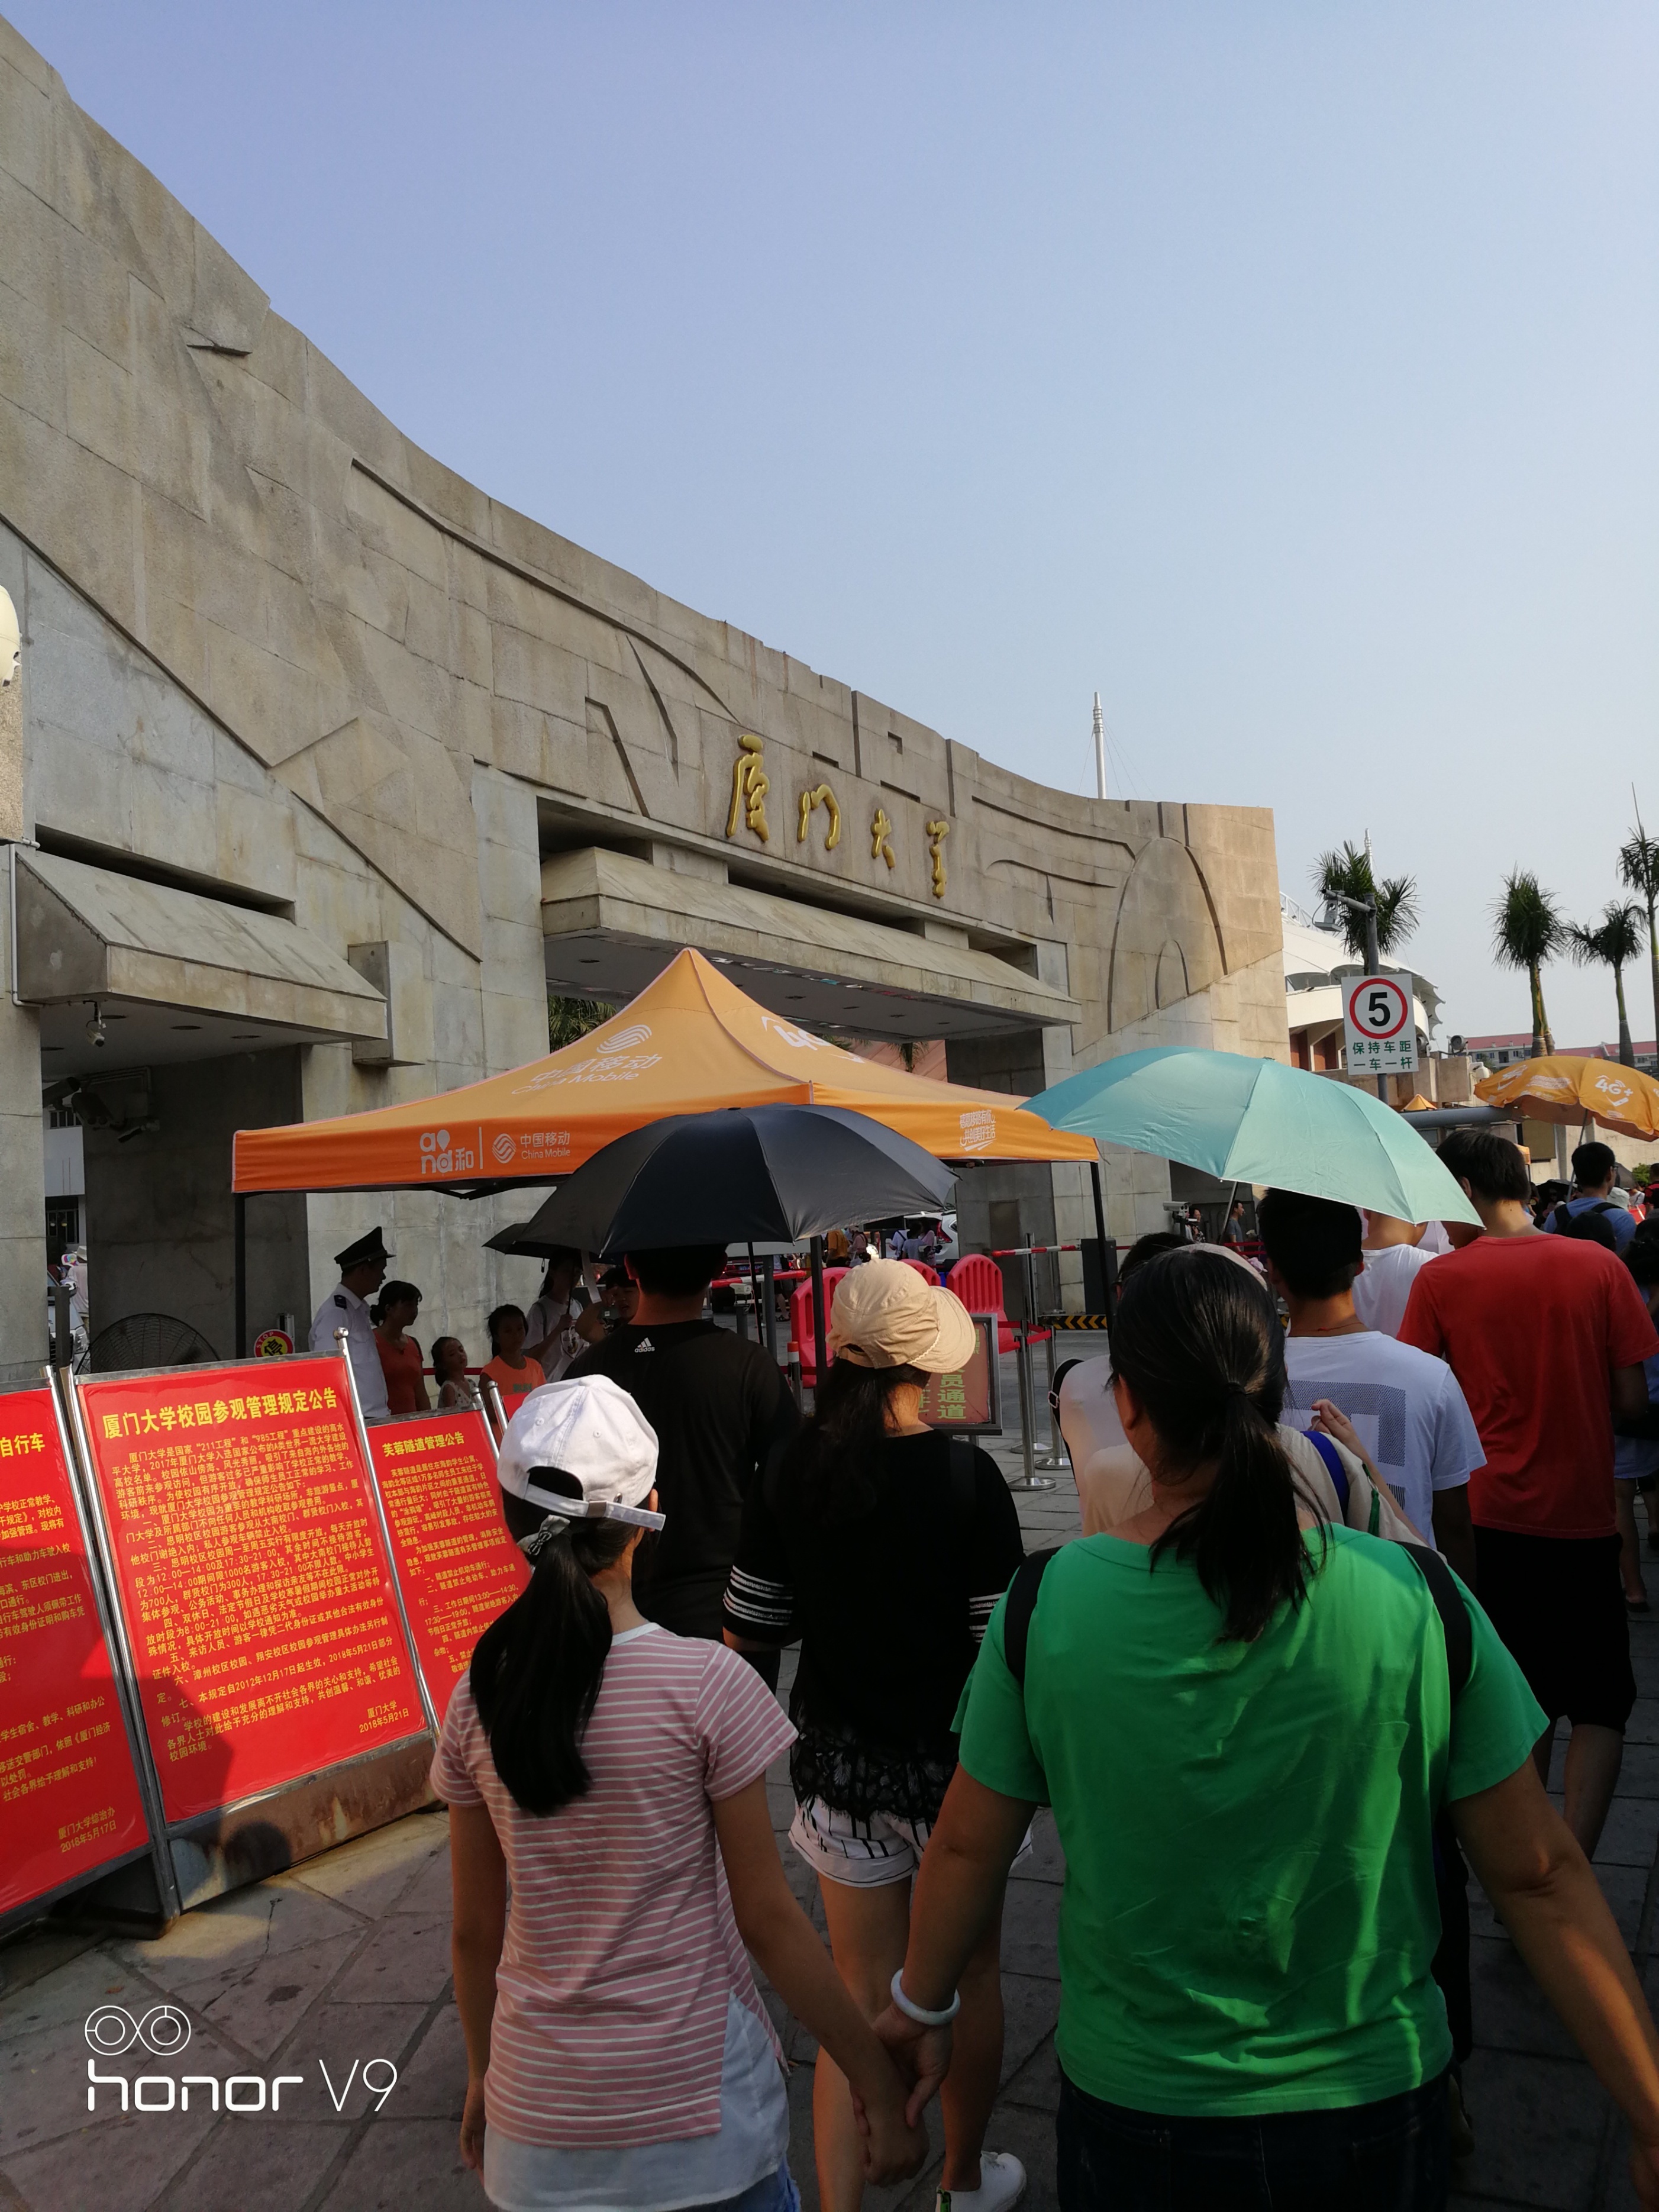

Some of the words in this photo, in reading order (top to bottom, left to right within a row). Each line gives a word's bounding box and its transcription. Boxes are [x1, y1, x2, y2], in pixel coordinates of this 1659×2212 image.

[1368, 992, 1390, 1027] 5
[1353, 1040, 1412, 1055] 保持车距
[531, 1054, 663, 1082] 中国移动
[1354, 1057, 1413, 1070] 一车一杆
[511, 1078, 566, 1094] China
[568, 1071, 640, 1084] Mobile
[520, 1131, 570, 1148] 中国移动
[521, 1150, 544, 1159] China
[545, 1149, 570, 1158] Mobile
[937, 1369, 966, 1419] 员通道
[102, 1387, 337, 1439] 厦门大学校园参观管理规定公告
[0, 1433, 45, 1458] 自行车
[382, 1431, 464, 1457] 芙蓉隧道管理公告
[0, 1594, 82, 1624] 行车驾驶人须佩带工作
[152, 1660, 195, 1679] 证件入校。
[161, 1712, 186, 1727] 修订。
[359, 1708, 409, 1733] 2018年5月21日
[367, 1700, 397, 1718] 厦门大学
[169, 1740, 212, 1762] 校园环境。
[60, 1820, 116, 1853] 2018年5月17日
